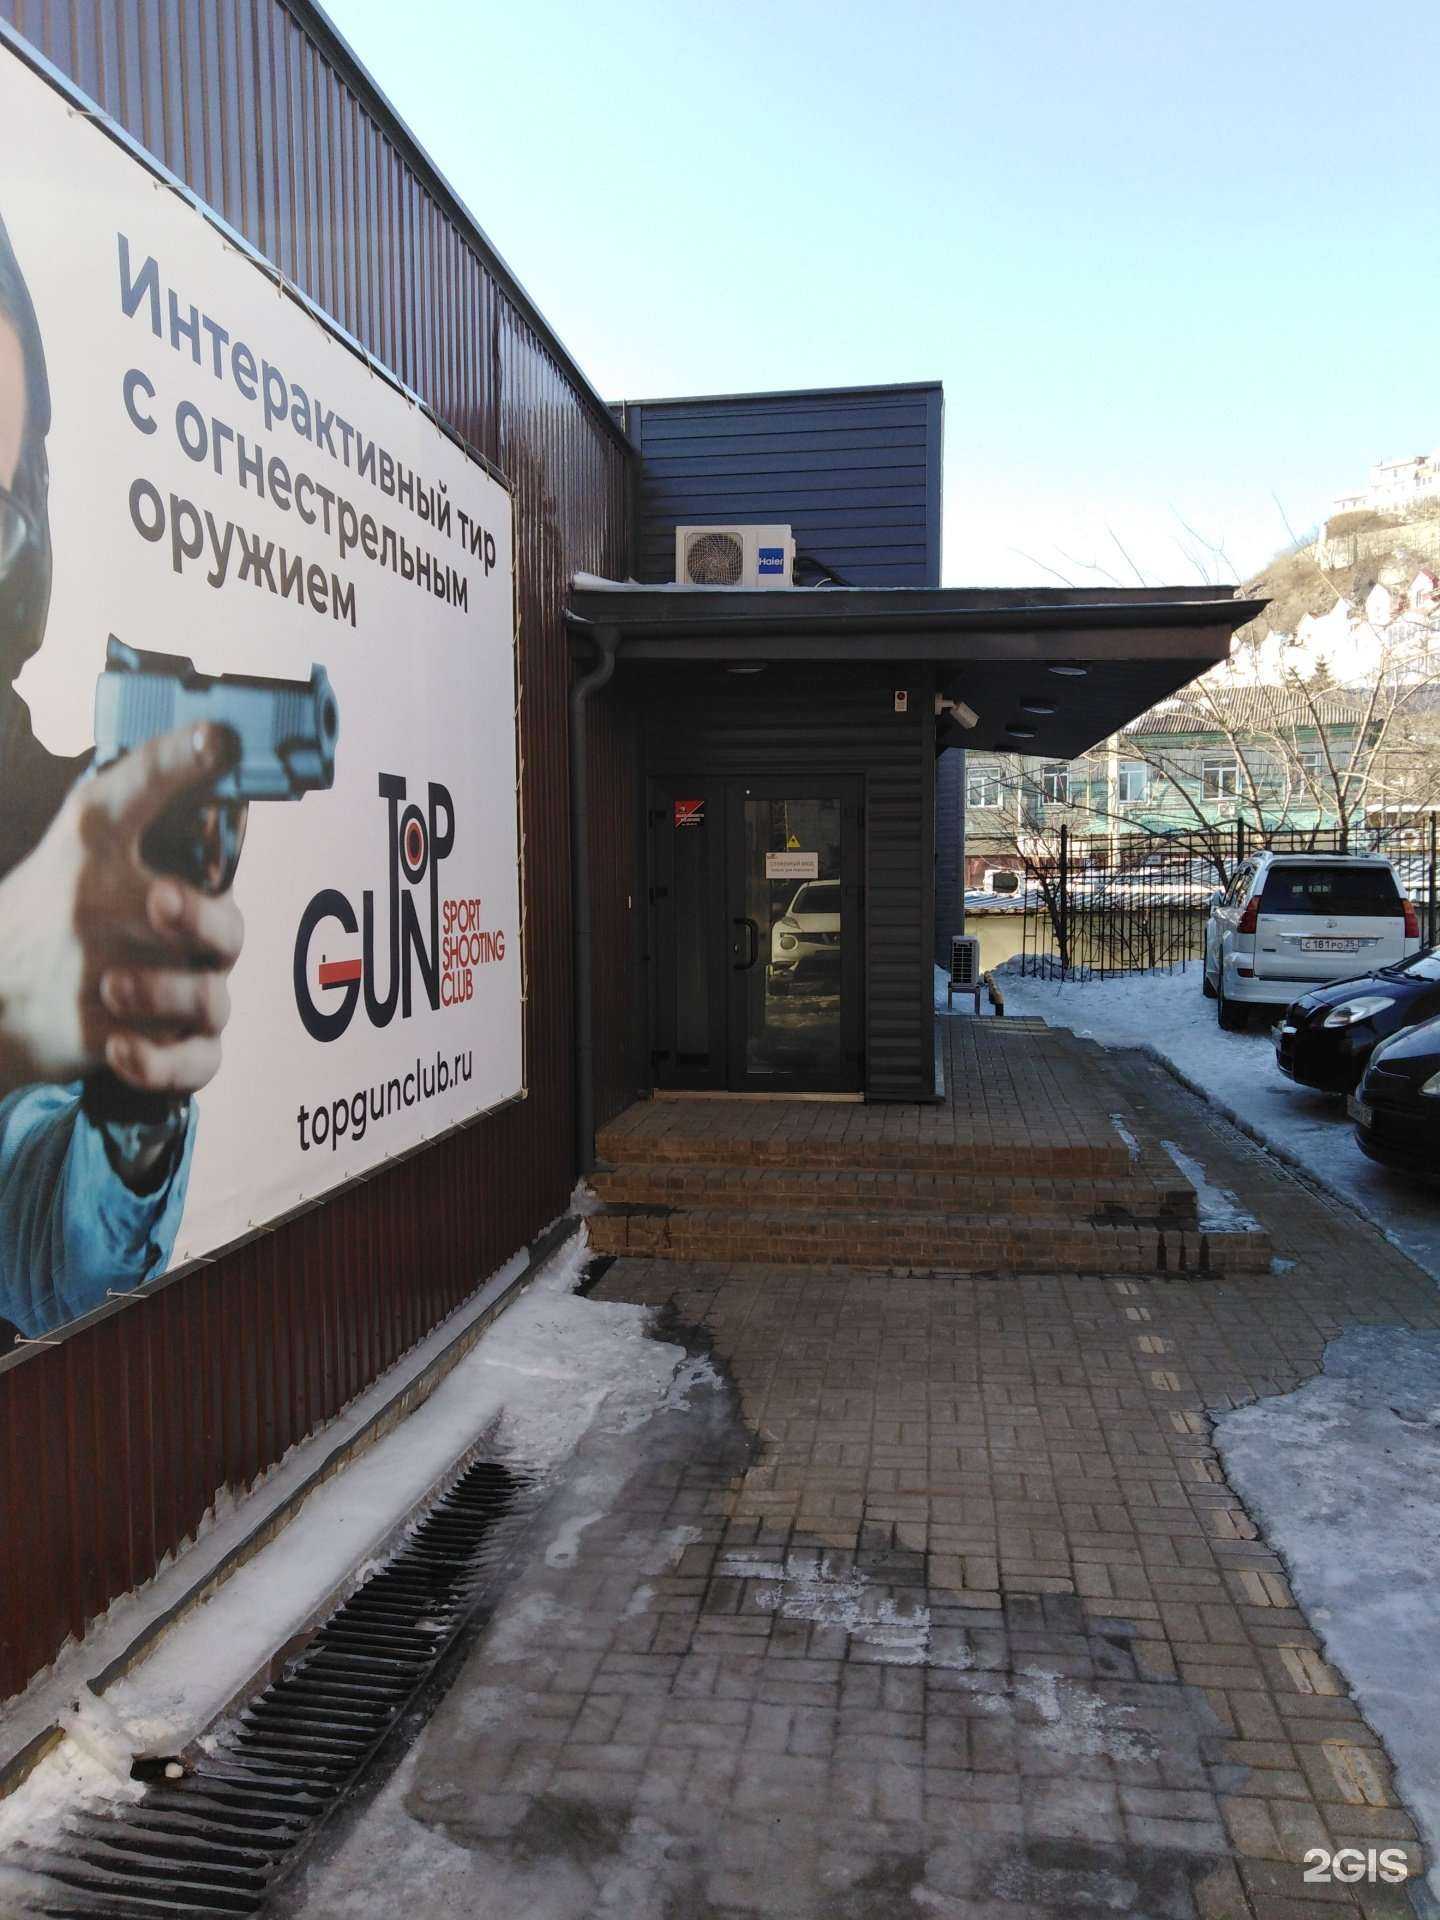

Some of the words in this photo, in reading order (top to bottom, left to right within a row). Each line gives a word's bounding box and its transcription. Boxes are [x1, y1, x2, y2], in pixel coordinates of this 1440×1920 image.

[117, 232, 452, 538] Интерактивный
[457, 510, 497, 577] тир
[122, 368, 158, 435] с
[175, 400, 469, 613] огнестрельным
[129, 478, 357, 628] оружием
[759, 557, 784, 566] Haier
[293, 888, 440, 1043] GUN
[442, 899, 481, 934] SPORT
[442, 930, 505, 971] SHOOTING
[440, 968, 474, 1008] CLUB
[297, 1050, 472, 1152] topgunclub.ru
